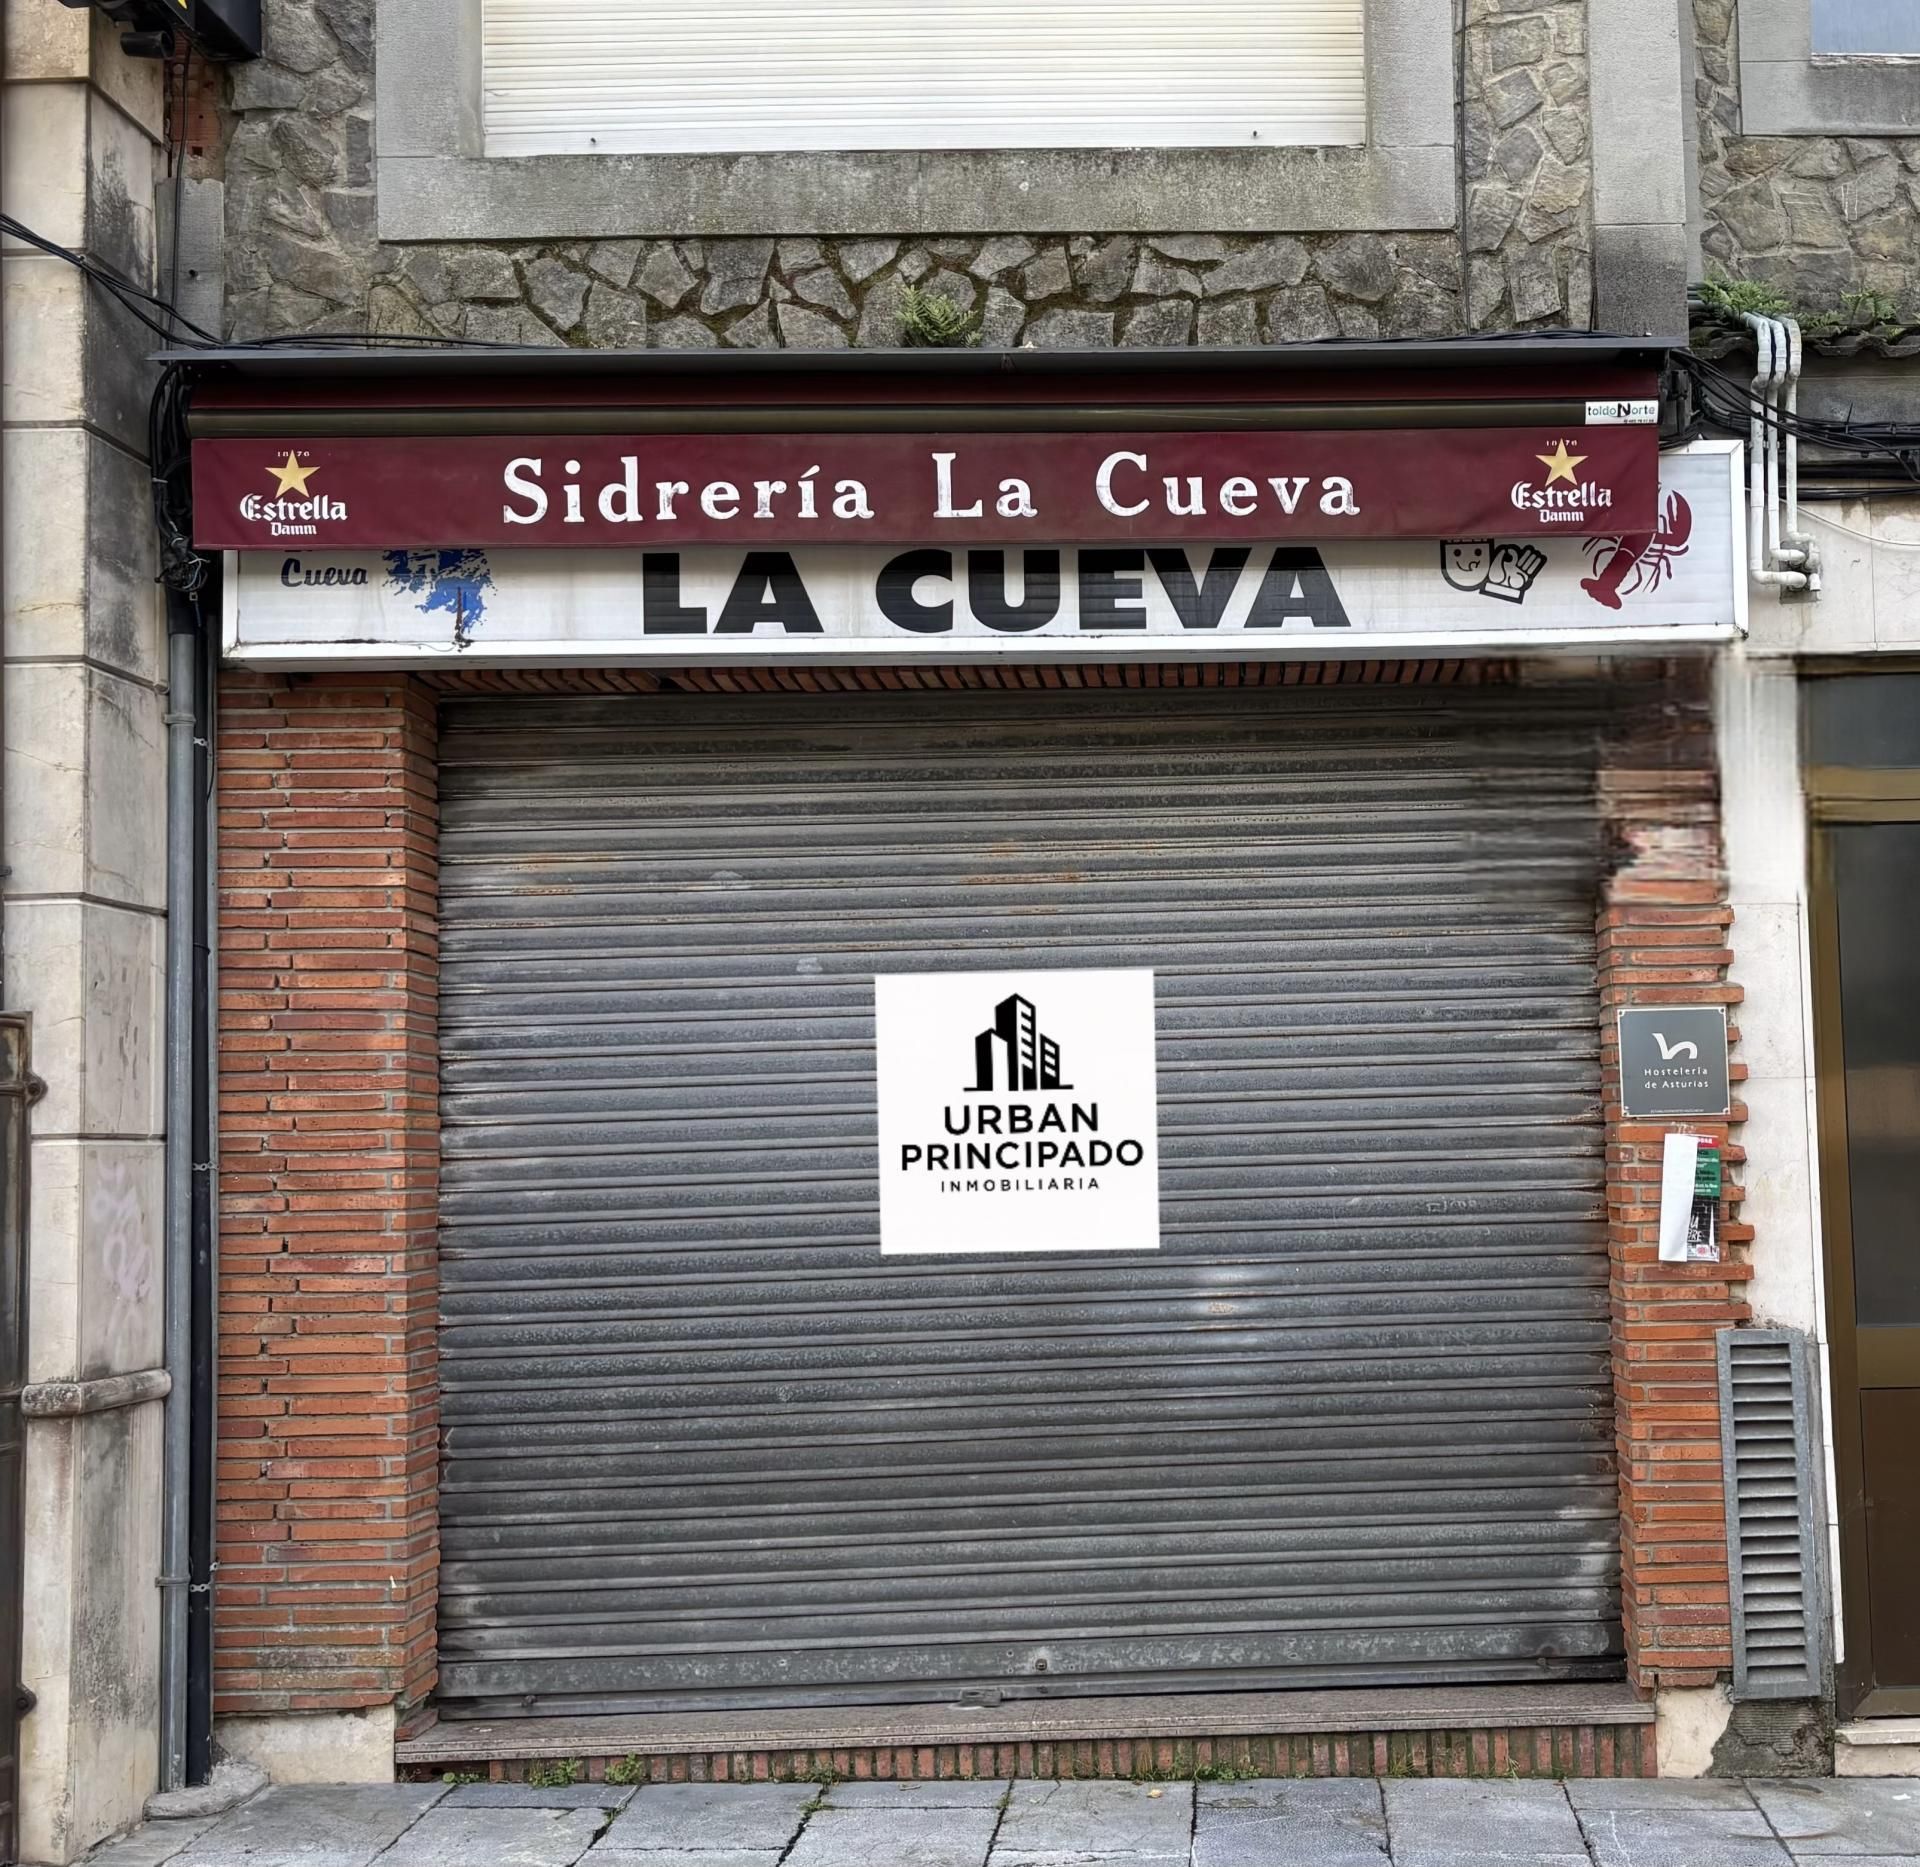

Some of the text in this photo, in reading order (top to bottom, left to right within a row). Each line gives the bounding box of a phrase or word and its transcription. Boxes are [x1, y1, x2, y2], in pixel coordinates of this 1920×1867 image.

[503, 451, 1361, 525] Sidrería La Cueva
[1511, 481, 1613, 509] Estrella
[240, 493, 348, 522] Estrella
[1539, 509, 1585, 523] Damm
[270, 522, 317, 536] Damm
[281, 558, 369, 587] Cueva
[642, 546, 1352, 635] LA CUEVA
[1644, 1080, 1709, 1089] de Asturias
[944, 1102, 1098, 1135] URBAN
[901, 1139, 1144, 1171] PRINCIPADO
[941, 1177, 1100, 1193] INMOBILIARIA
